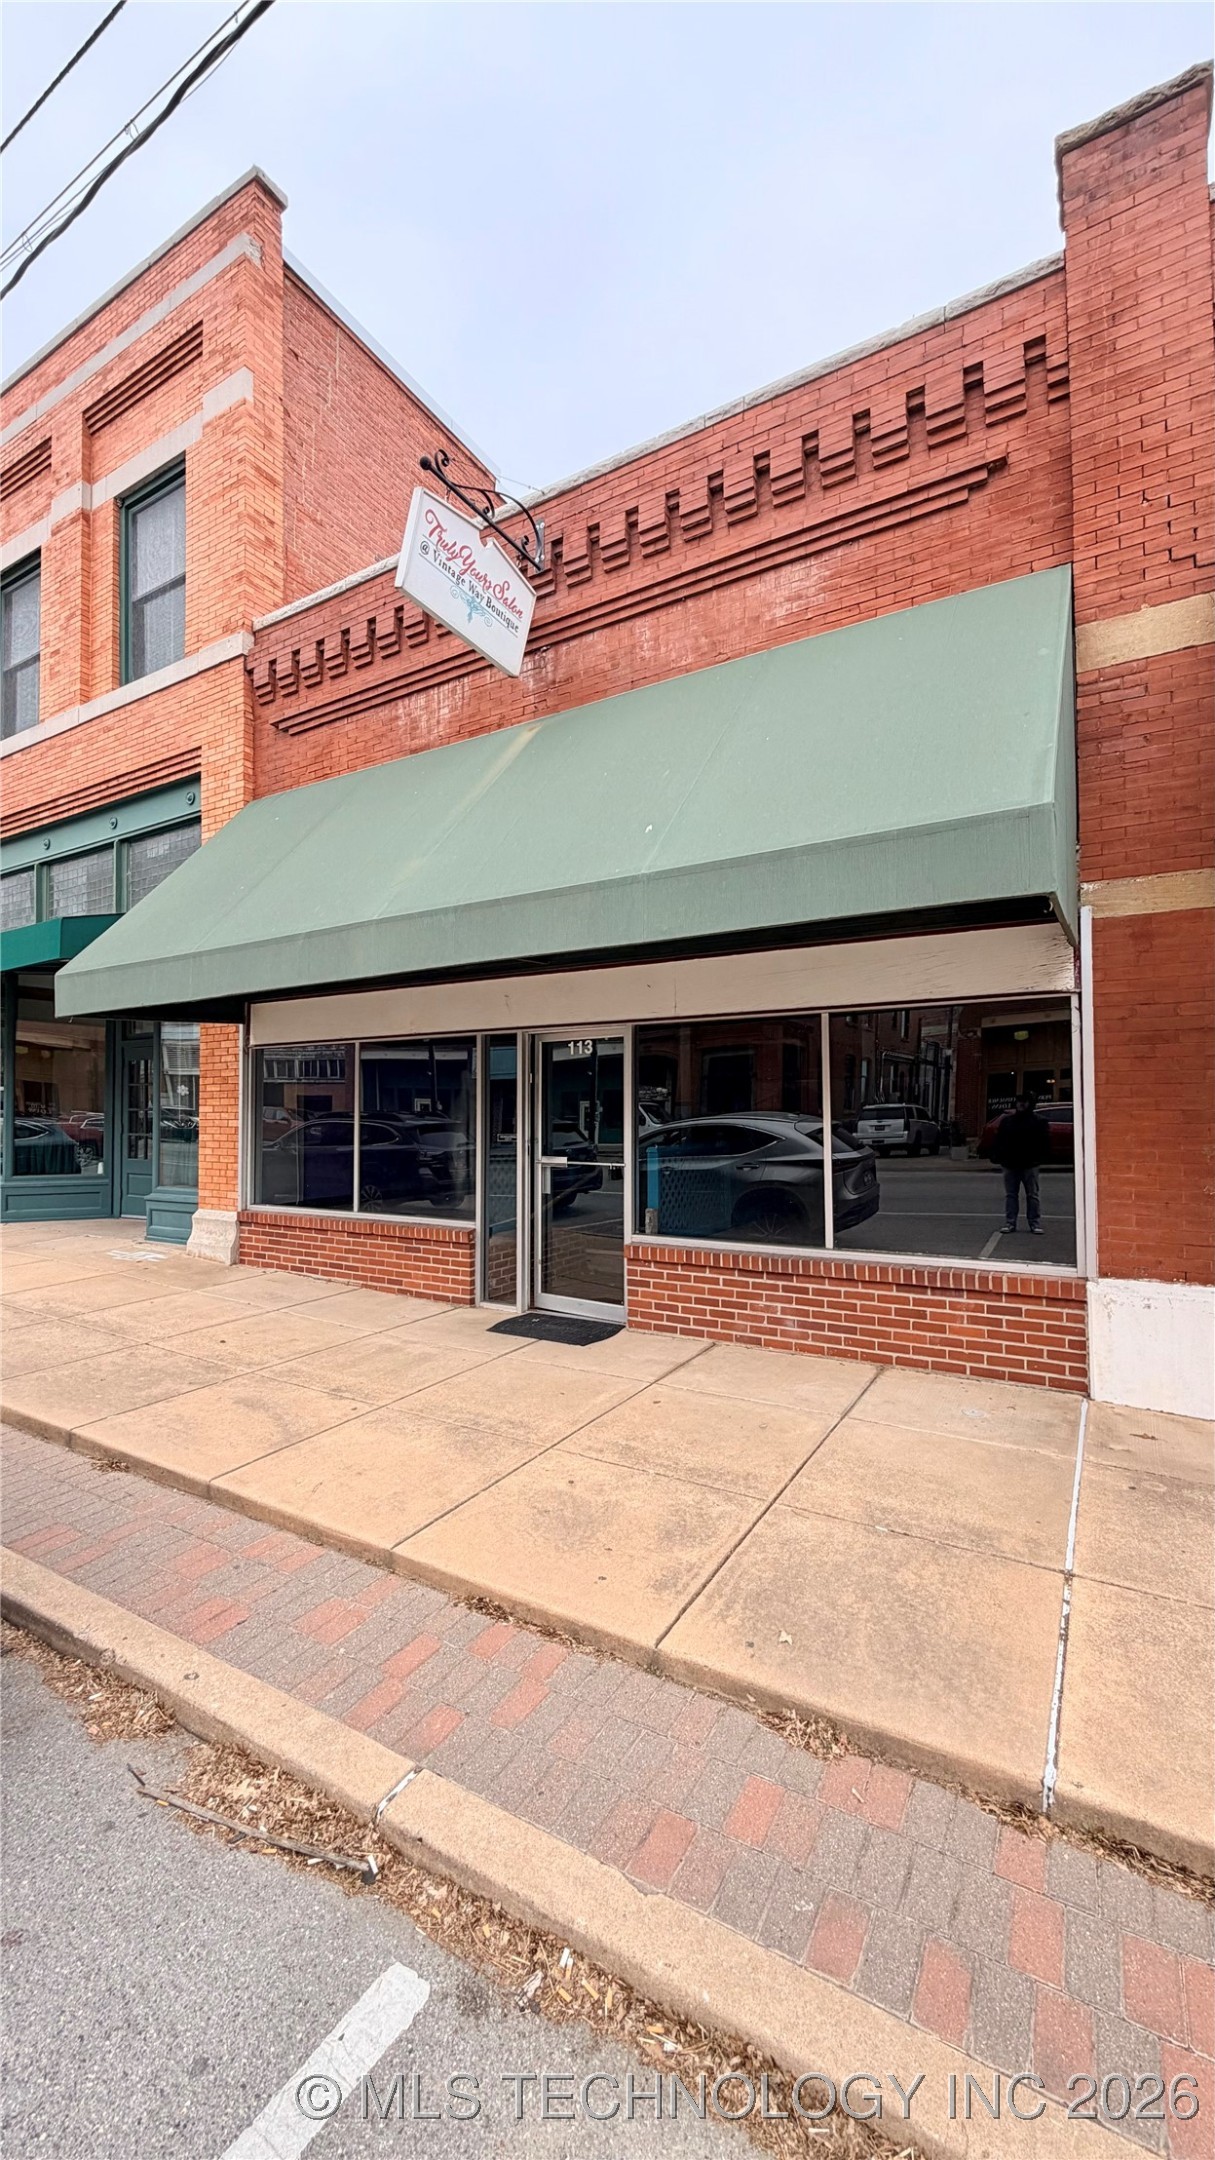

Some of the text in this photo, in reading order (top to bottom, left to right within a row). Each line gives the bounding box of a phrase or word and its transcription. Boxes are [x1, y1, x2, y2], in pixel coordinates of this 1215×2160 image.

[420, 540, 519, 633] @ Vintage Way Boutique
[425, 509, 523, 619] Truly Yours Salon
[568, 1040, 593, 1055] 113
